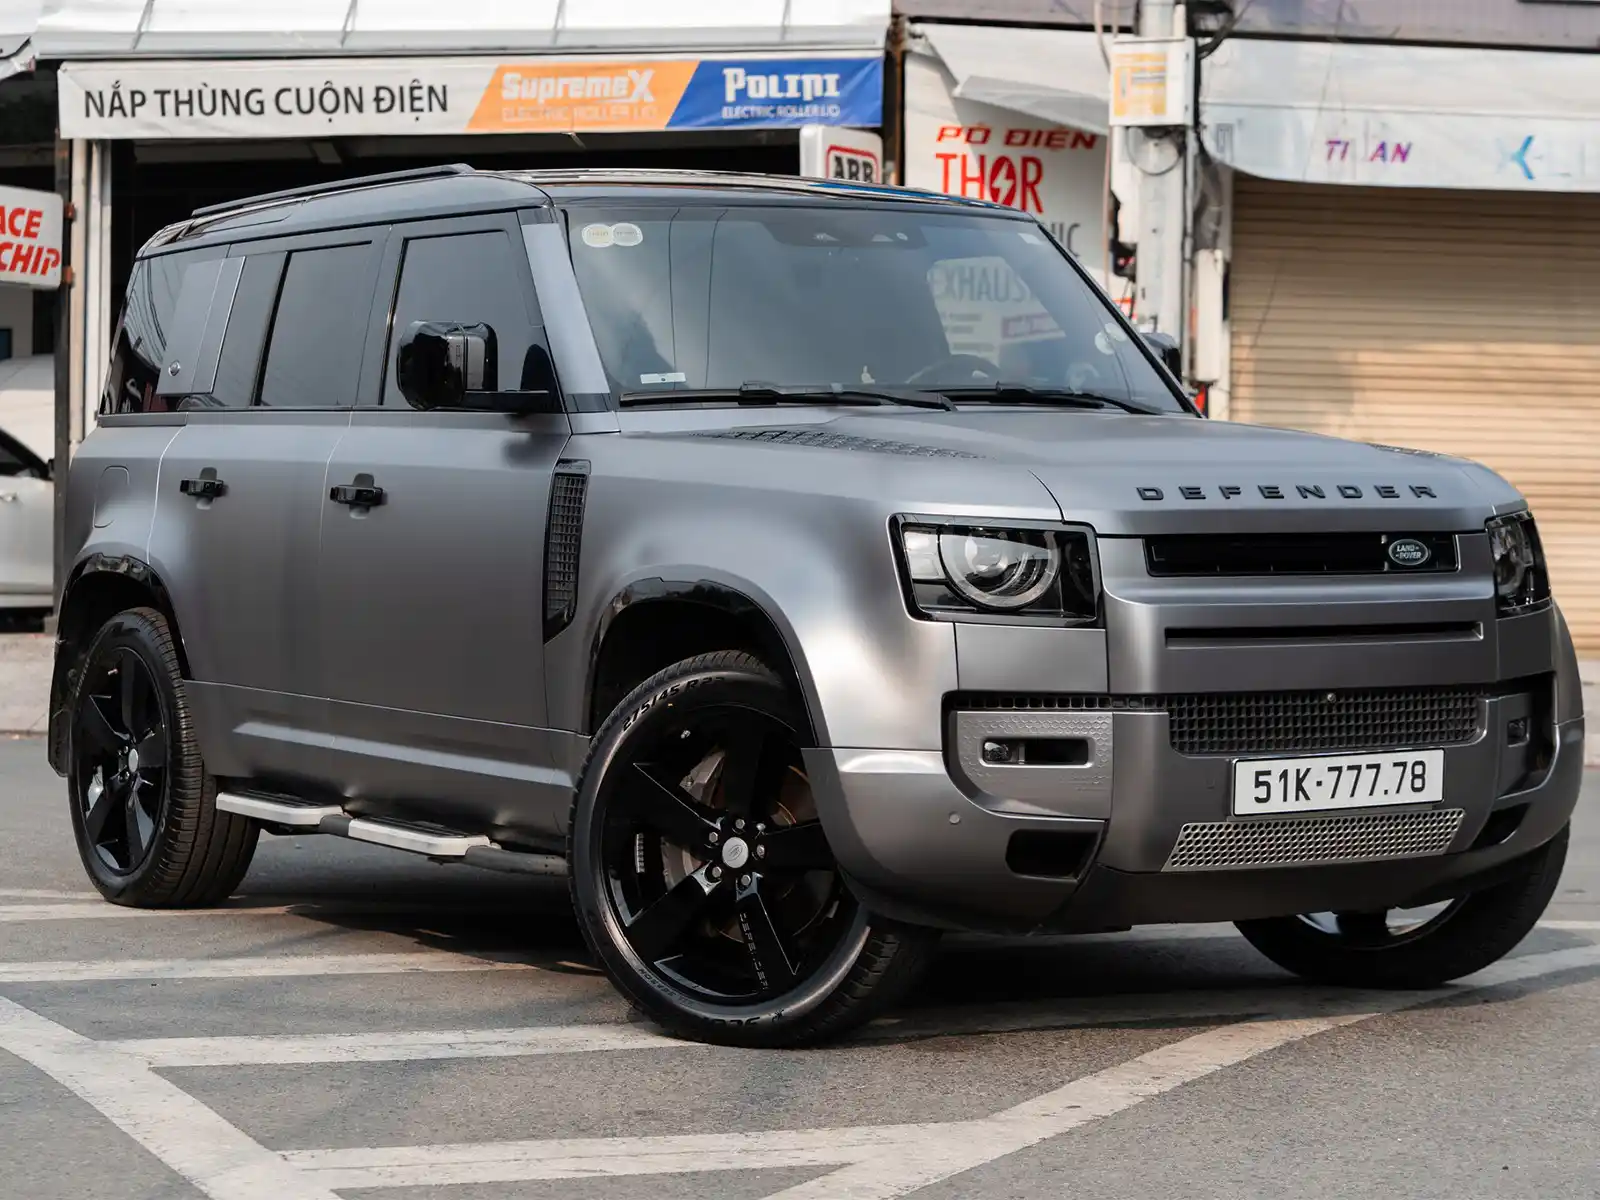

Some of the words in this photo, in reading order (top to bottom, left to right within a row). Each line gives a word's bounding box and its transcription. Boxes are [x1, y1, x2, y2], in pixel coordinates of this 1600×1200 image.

[85, 80, 146, 118] NẮP
[154, 82, 265, 117] THÙNG
[275, 80, 364, 122] CUỘN
[373, 78, 448, 121] ĐIỆN
[935, 153, 1044, 213] THOR
[1136, 484, 1438, 501] DEFENDER
[1253, 760, 1427, 804] 51K-777.78
